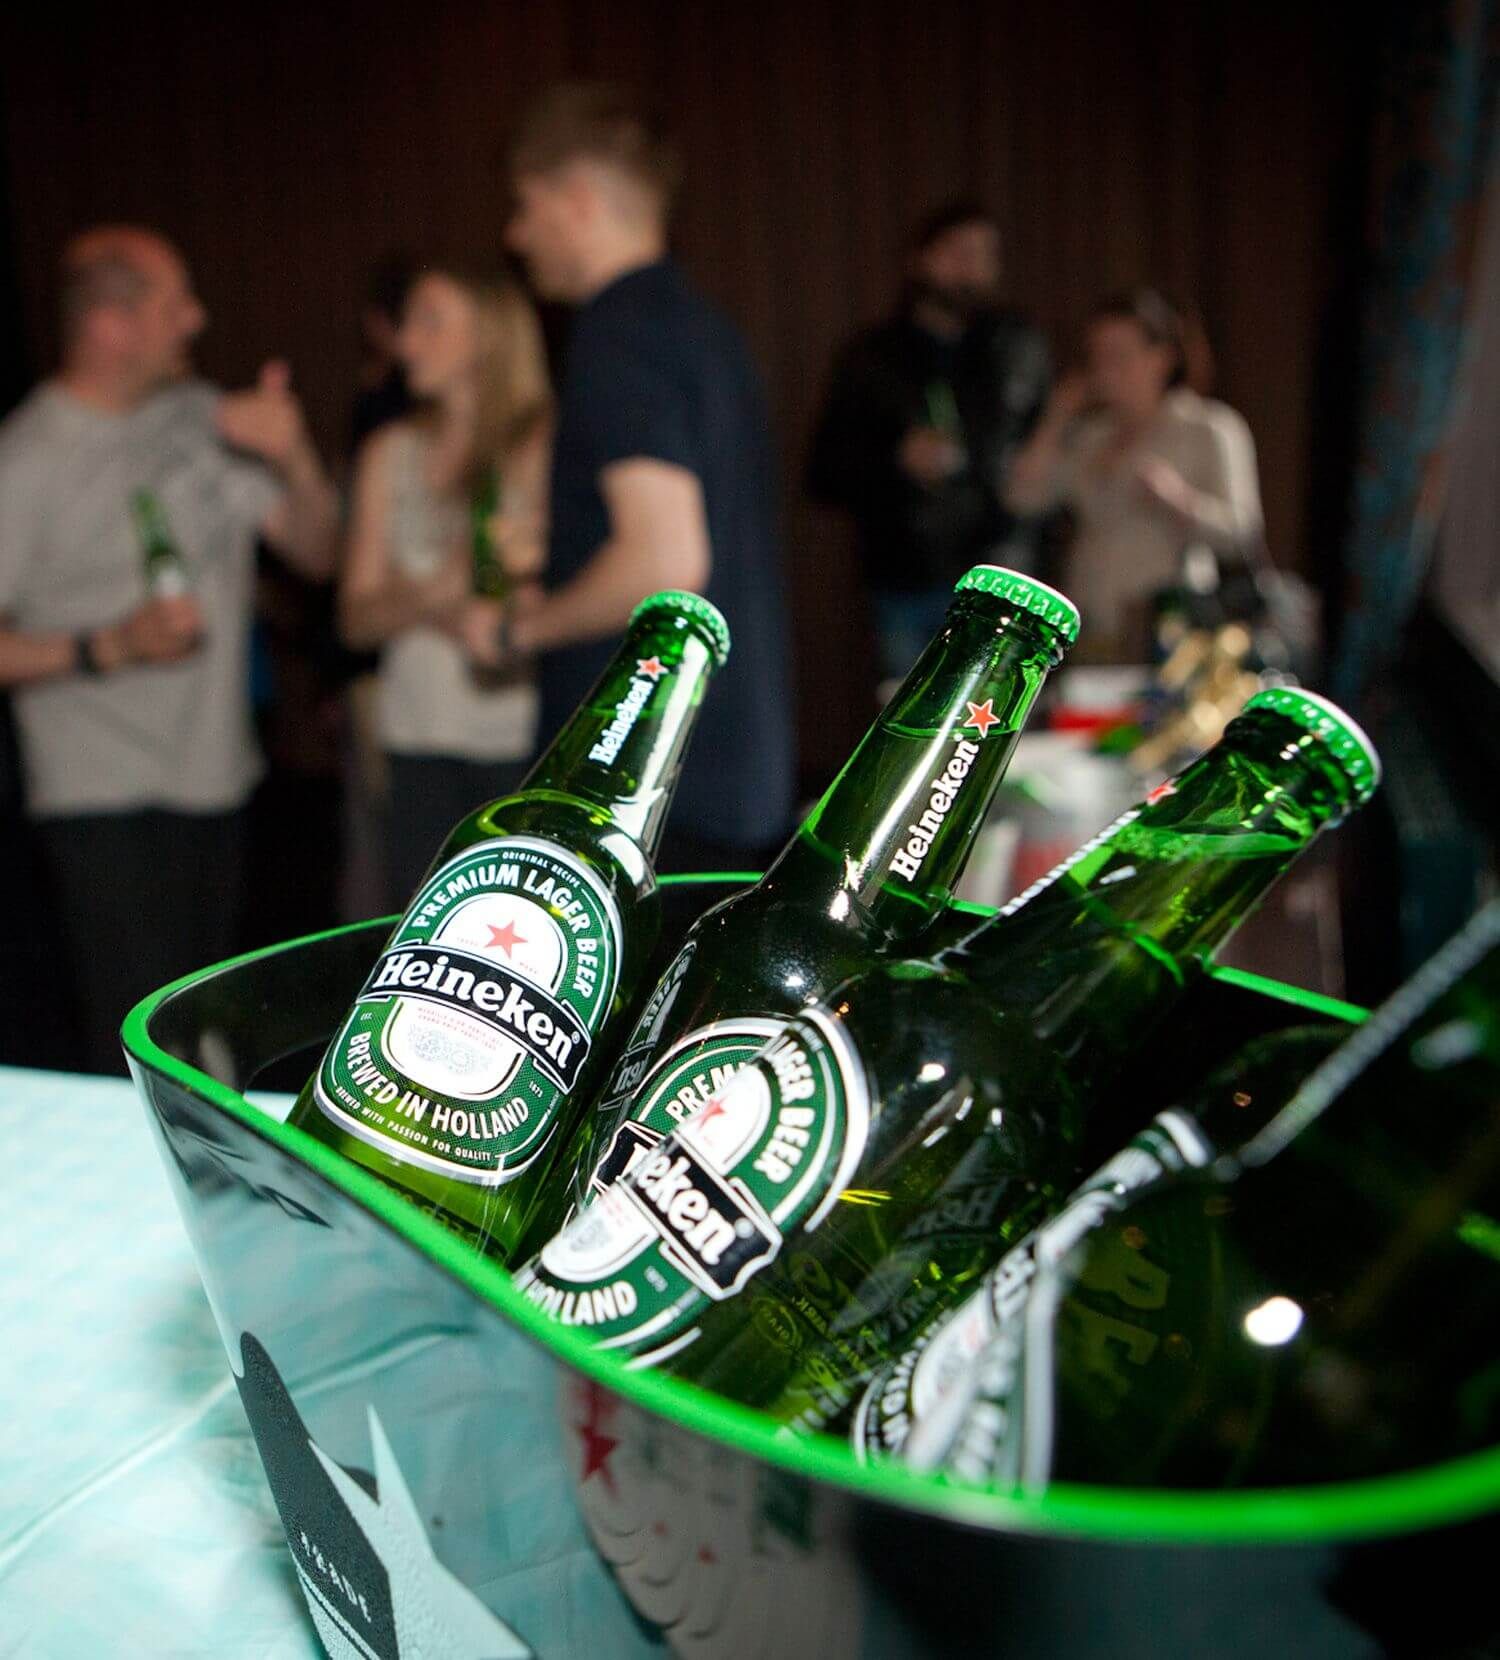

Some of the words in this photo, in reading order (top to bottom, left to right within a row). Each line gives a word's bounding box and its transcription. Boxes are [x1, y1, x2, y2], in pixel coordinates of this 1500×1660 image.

[588, 680, 654, 766] Heineken
[888, 740, 980, 882] Heineken
[502, 851, 549, 869] ORIGINAL
[550, 863, 581, 889] RECIPE
[412, 863, 521, 928] PREMIUM
[522, 868, 593, 934] LAGER
[572, 937, 600, 999] BEER
[372, 952, 573, 1070] Heineken
[346, 1031, 400, 1105] BREWED
[395, 1090, 430, 1122] IN
[431, 1096, 530, 1141] HOLLAND
[664, 1061, 746, 1124] PREM
[764, 1036, 816, 1106] AGER
[361, 1107, 386, 1125] WITH
[387, 1120, 429, 1145] PASSION
[432, 1139, 452, 1153] FOR
[455, 1146, 492, 1161] QUALITY
[752, 1106, 817, 1185] BEER
[636, 1153, 737, 1266] eken
